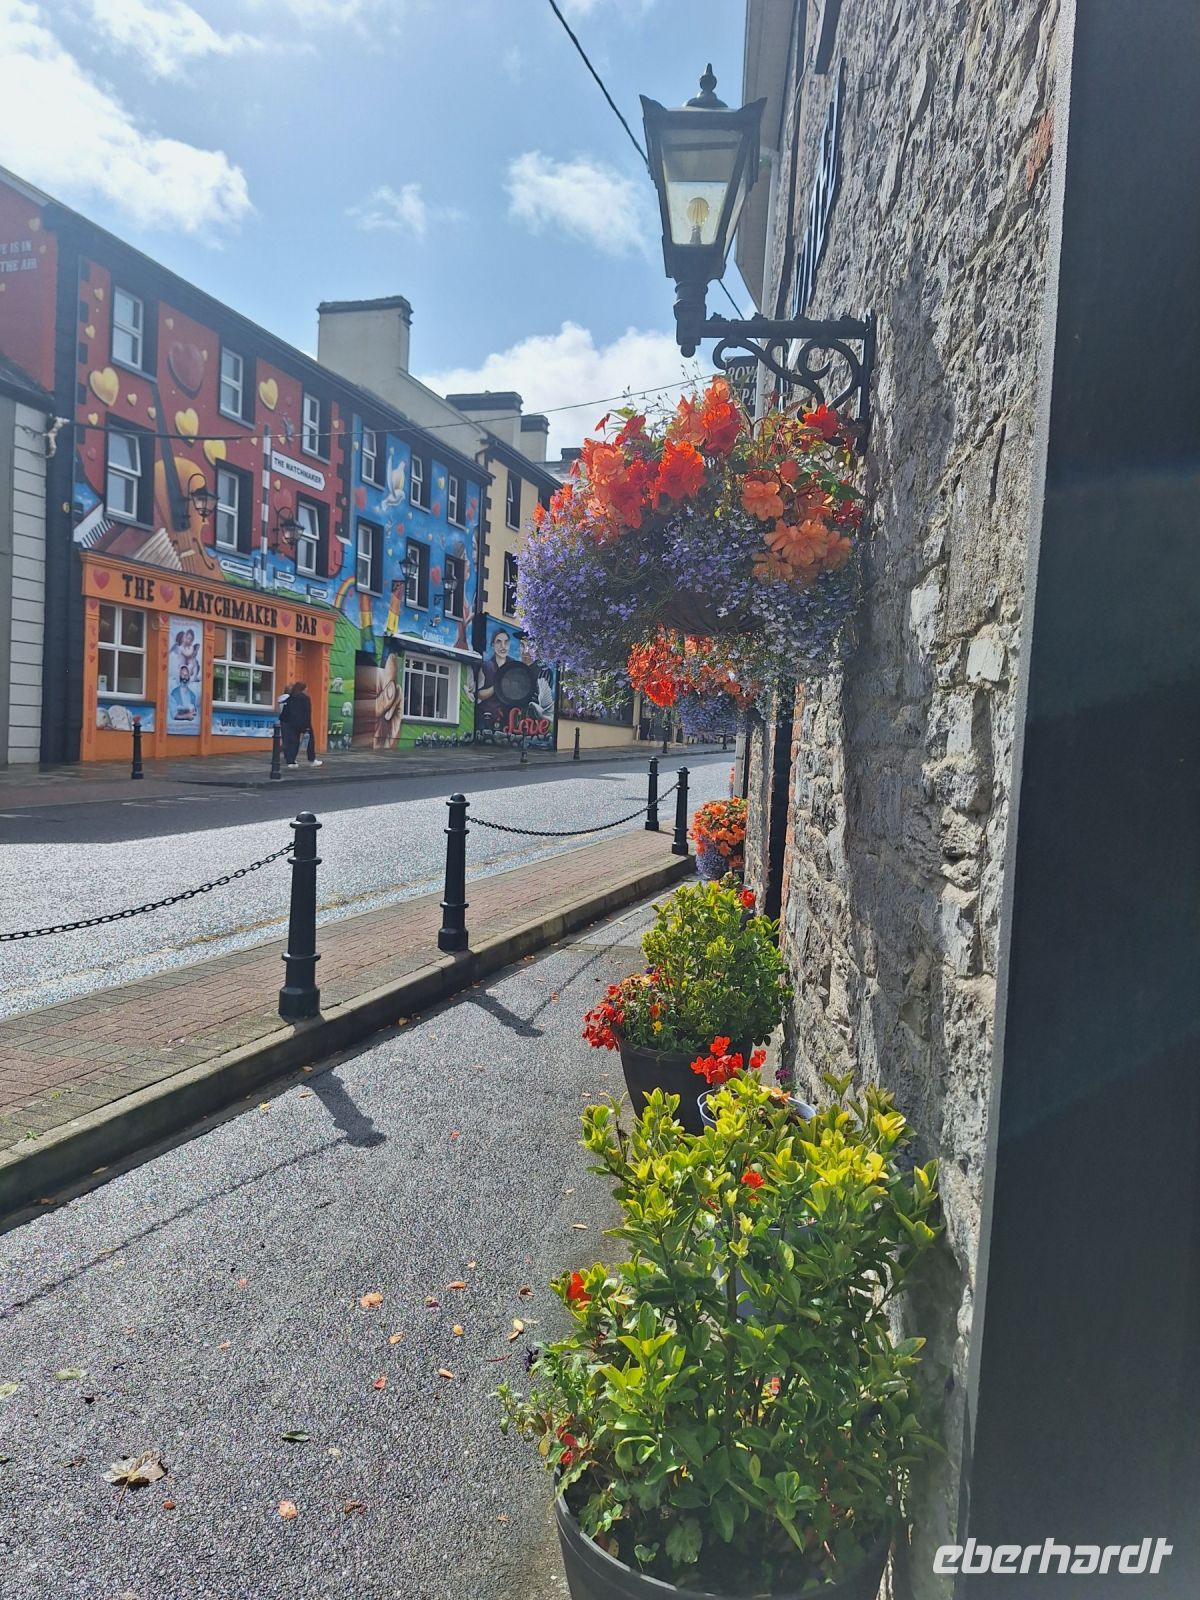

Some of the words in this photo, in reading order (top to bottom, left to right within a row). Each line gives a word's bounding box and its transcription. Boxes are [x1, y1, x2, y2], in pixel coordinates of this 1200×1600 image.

[0, 260, 18, 272] THE
[727, 366, 758, 384] ROYA
[274, 457, 285, 469] THE
[286, 462, 322, 484] MATCHMAKER
[122, 573, 155, 602] THE
[179, 586, 278, 628] MATCHMAKER
[296, 613, 317, 636] BAR
[422, 629, 445, 645] GUINNESS
[503, 707, 550, 736] Love
